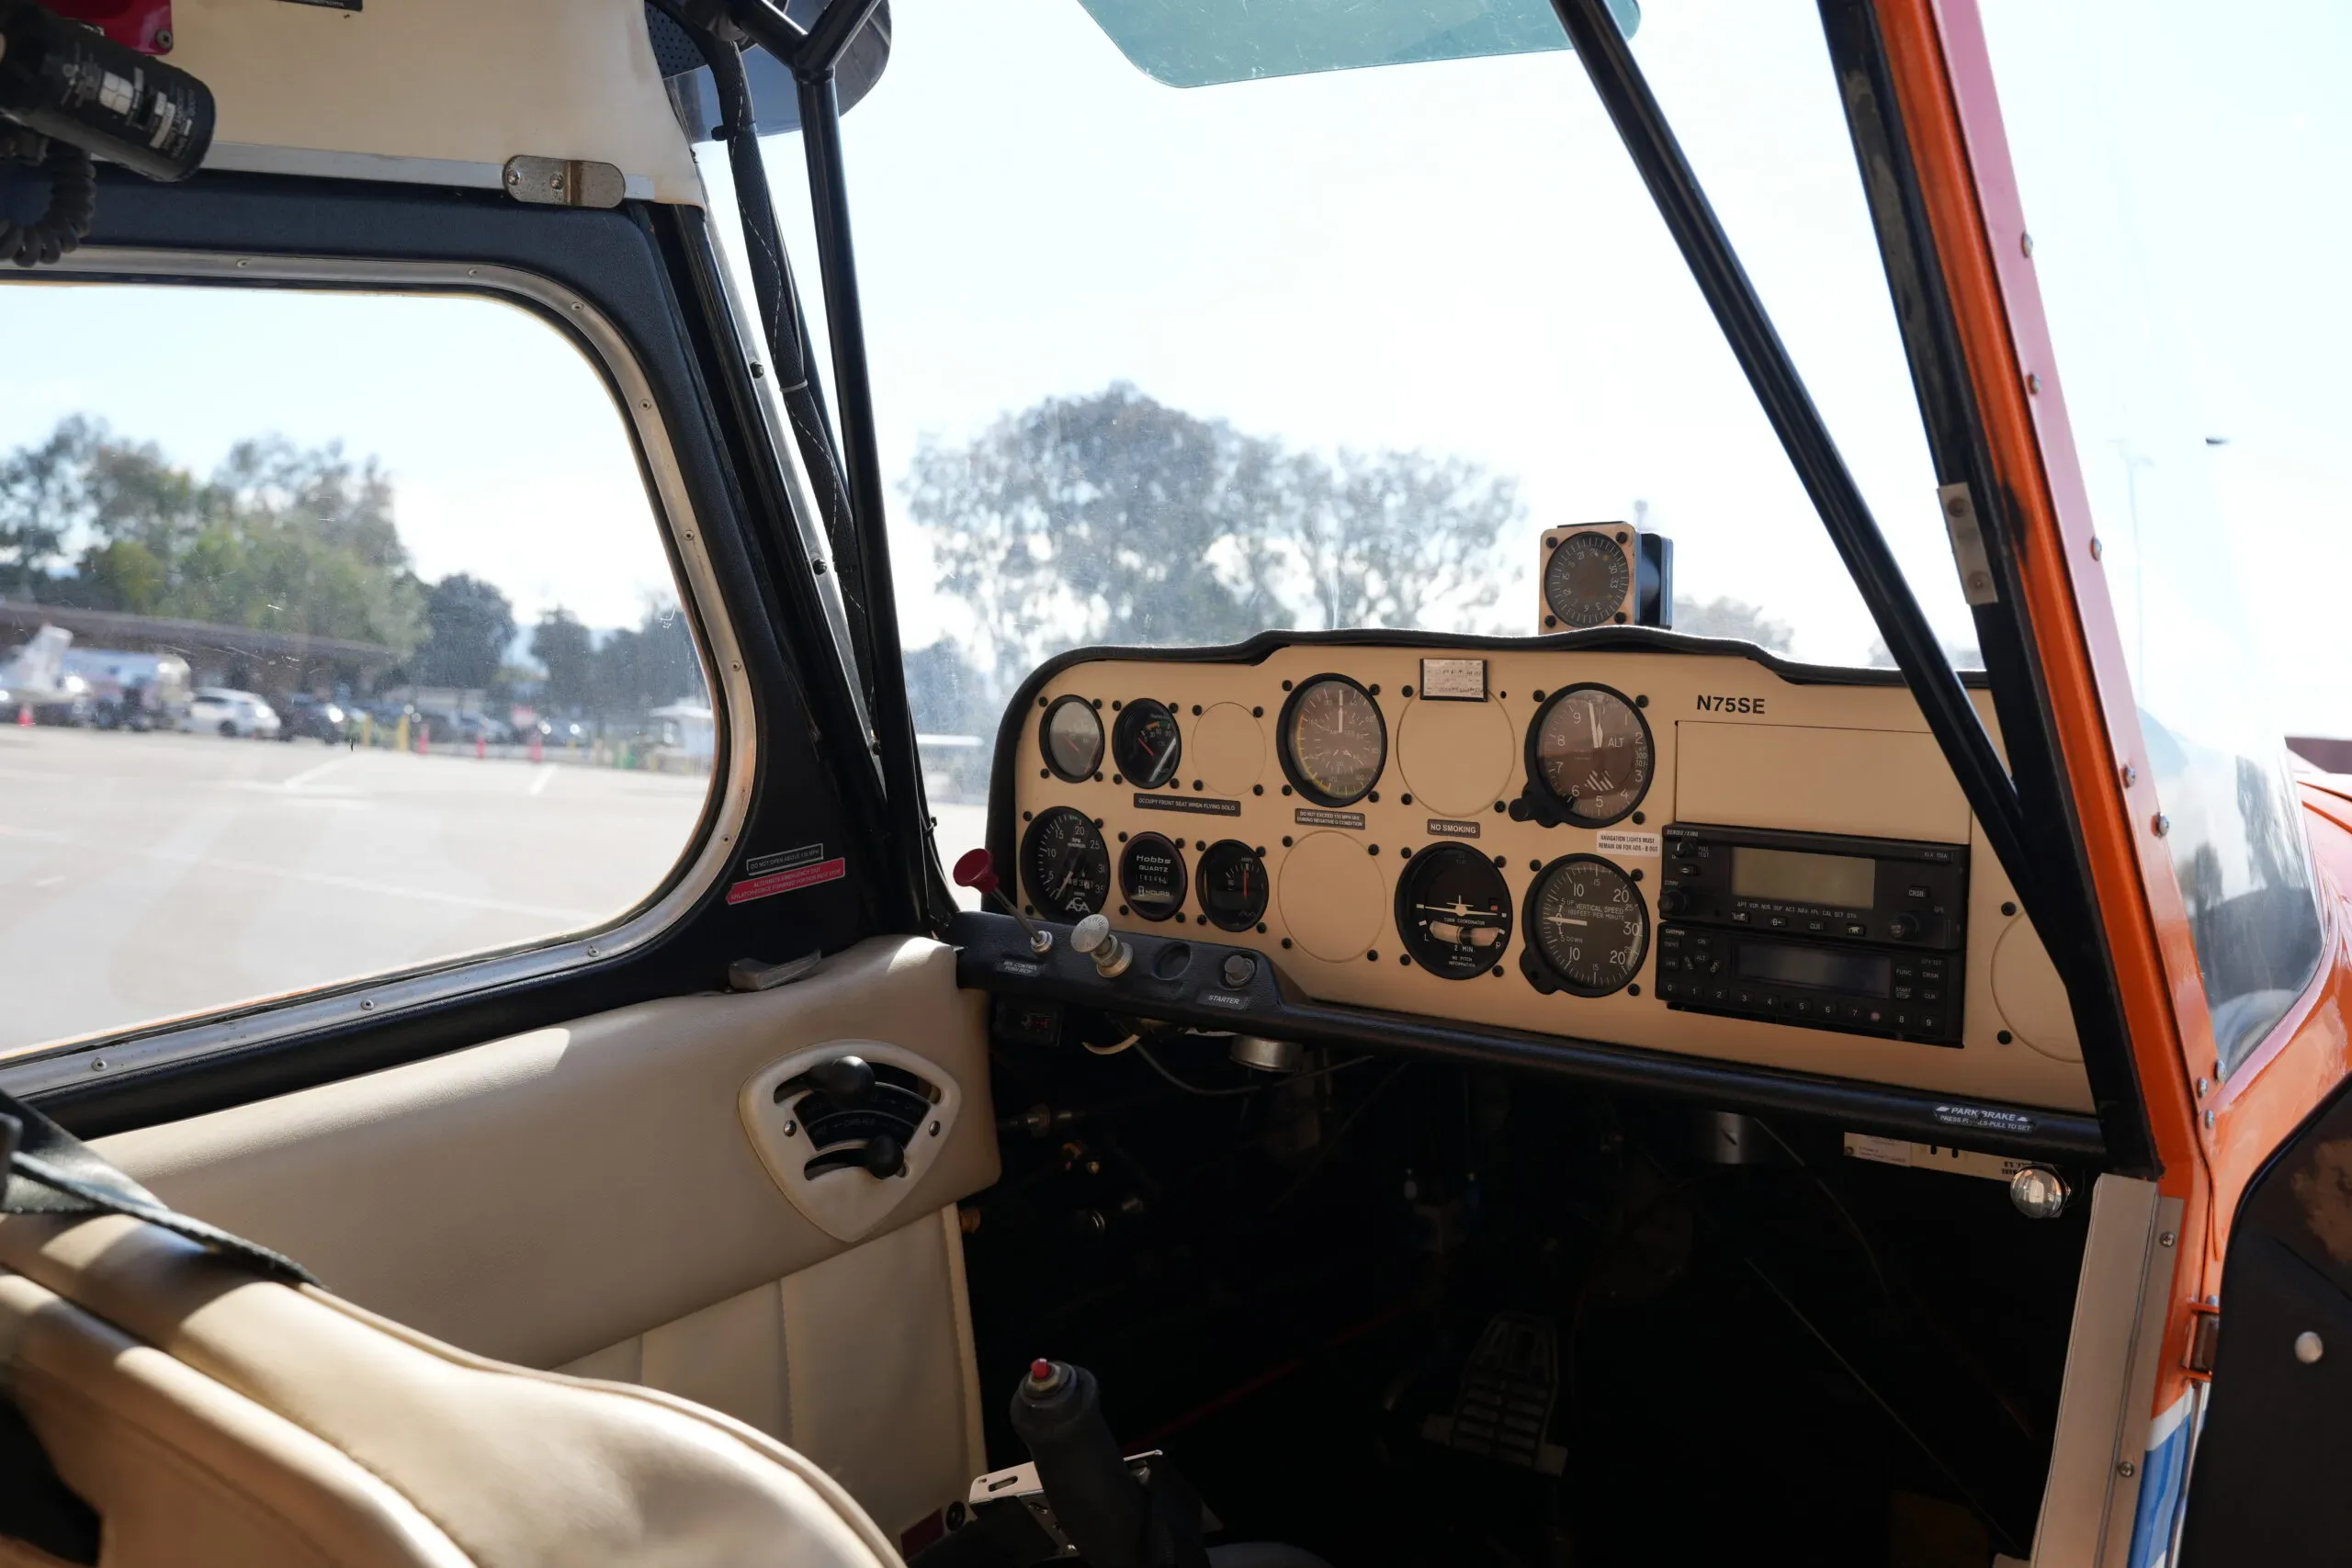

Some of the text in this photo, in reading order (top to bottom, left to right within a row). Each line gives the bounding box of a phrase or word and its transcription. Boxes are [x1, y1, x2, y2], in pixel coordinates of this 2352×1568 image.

[1697, 694, 1765, 715] N75SE
[1573, 713, 1580, 724] 9
[1557, 735, 1566, 747] 8
[1608, 738, 1624, 748] ALT
[1635, 732, 1643, 744] 2
[1556, 761, 1564, 773] 7
[1635, 770, 1643, 783] 3
[1572, 785, 1580, 797] 6
[1620, 788, 1629, 799] 4
[1138, 797, 1158, 806] OCCUPY
[1596, 795, 1603, 807] 5
[1055, 829, 1064, 840] 15
[1075, 827, 1084, 837] 20
[1442, 824, 1476, 834] SMOKING
[1090, 840, 1100, 850] 25
[1047, 849, 1057, 858] 10
[1136, 854, 1171, 864] Hobbs
[1138, 864, 1169, 873] QUARTZ
[1049, 871, 1055, 880] 5
[1574, 883, 1584, 897] 10
[1612, 888, 1629, 903] 20
[1576, 903, 1624, 915] VERTICAL SPEED
[1623, 921, 1639, 936] 30
[1570, 947, 1580, 961] 10
[1610, 950, 1625, 964] 20
[1208, 995, 1240, 1005] STARTER
[1951, 1107, 2017, 1121] PARK BRAKE
